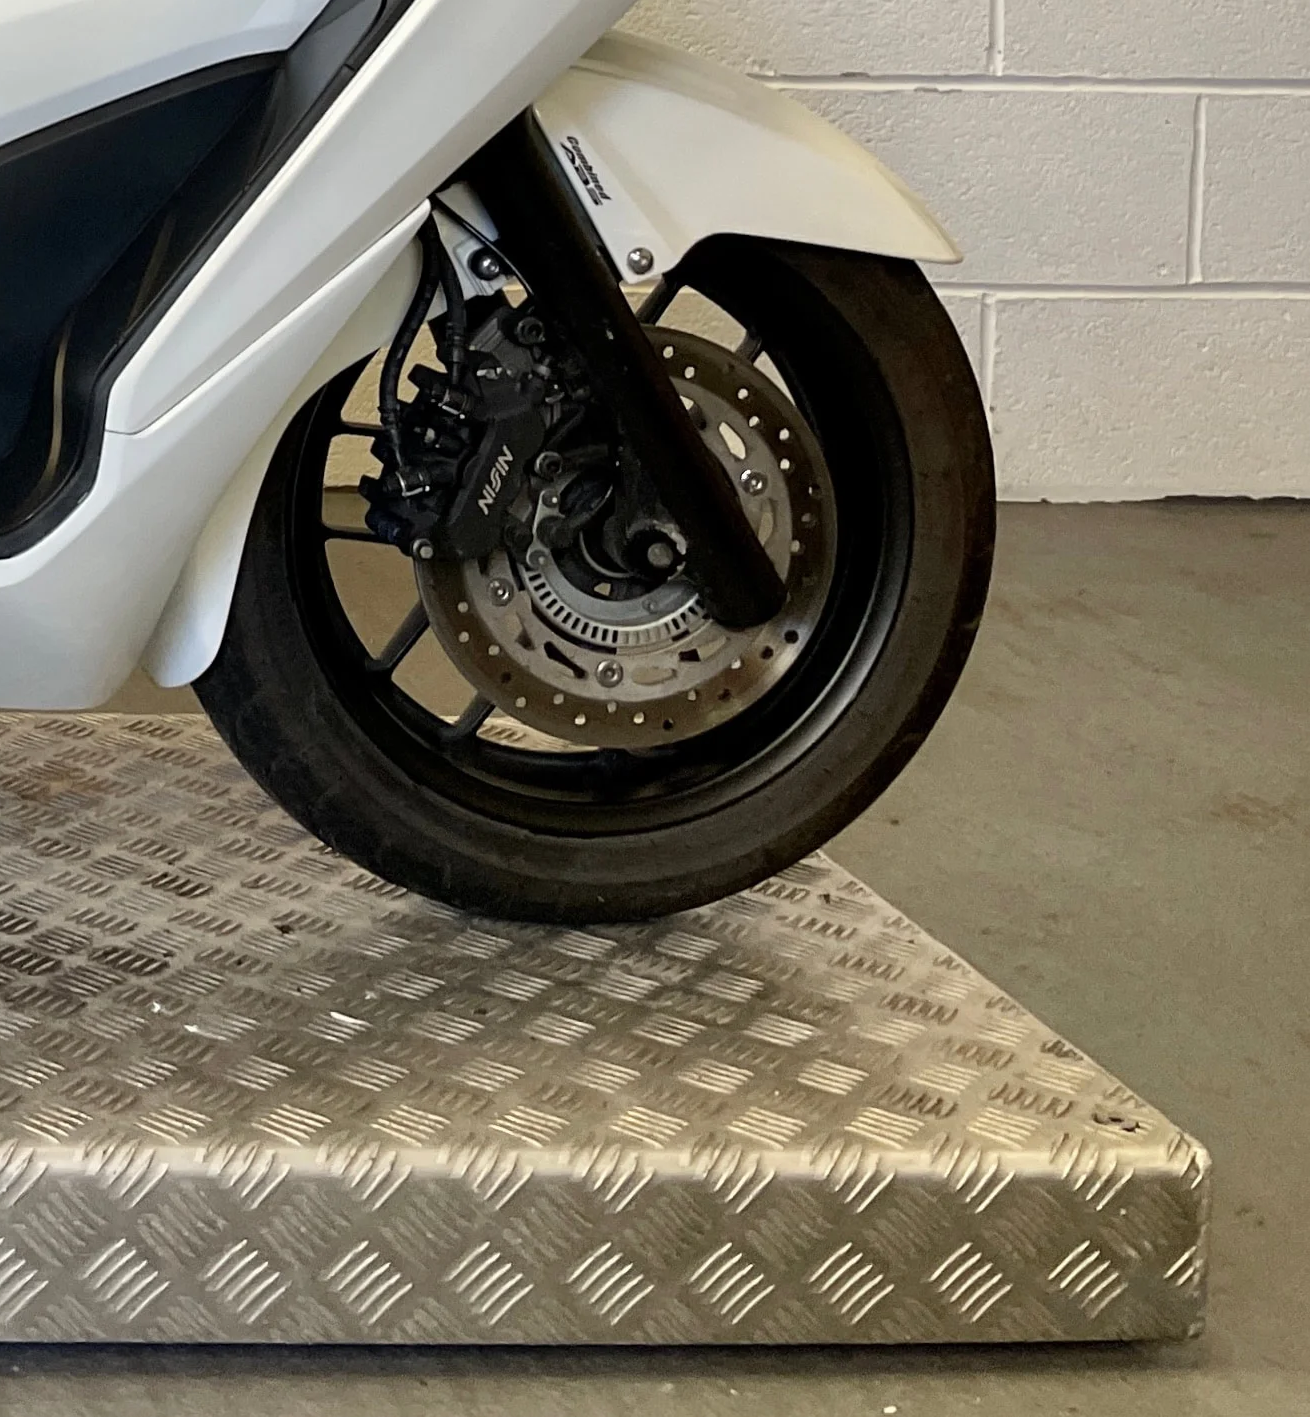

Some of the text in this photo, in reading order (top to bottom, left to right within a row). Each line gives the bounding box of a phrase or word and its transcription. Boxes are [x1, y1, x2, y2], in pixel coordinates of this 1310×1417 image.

[560, 141, 603, 206] ABS
[566, 135, 612, 201] Combined
[477, 444, 514, 516] NISSIN
